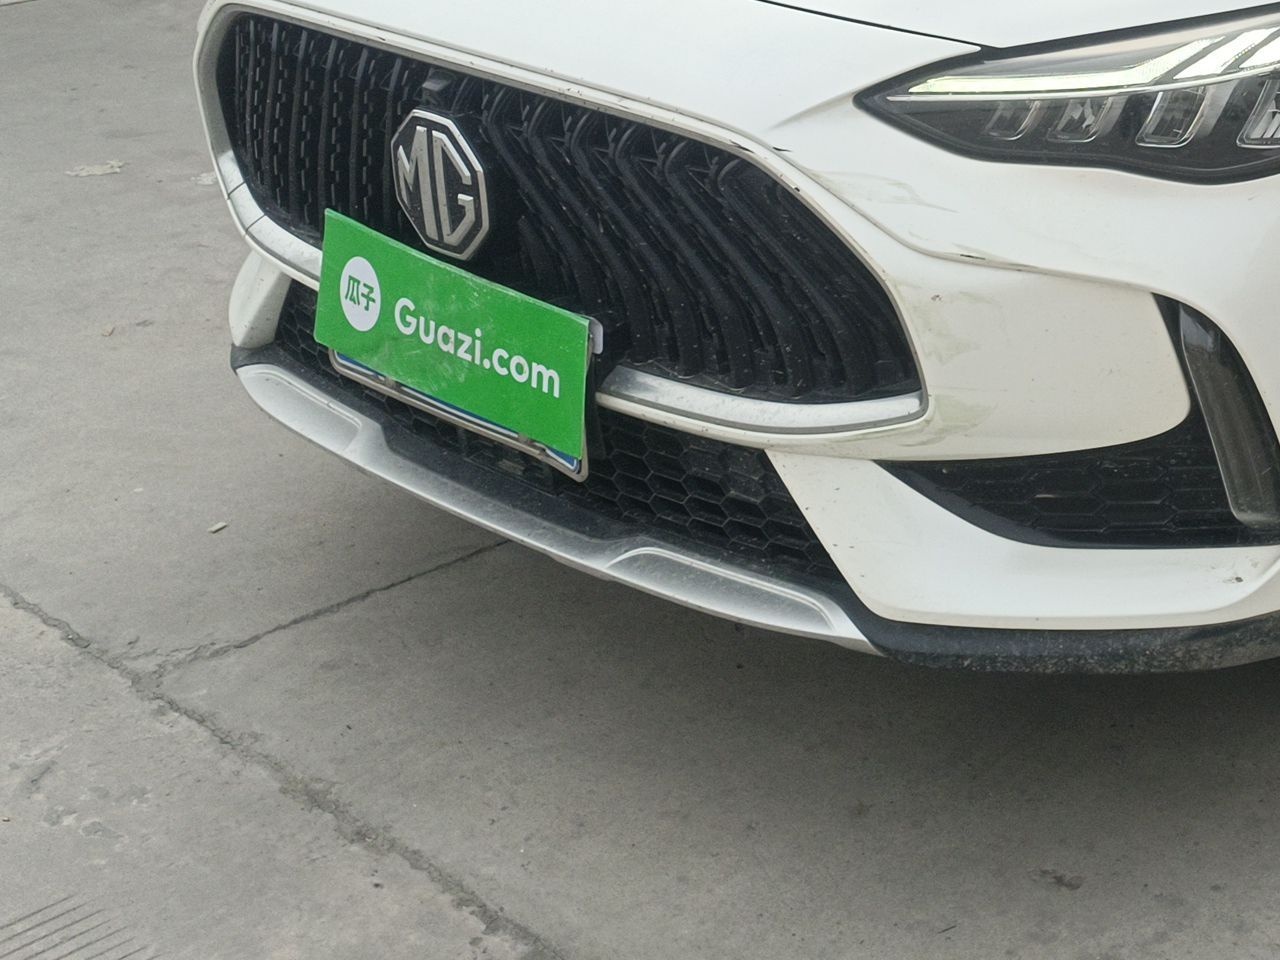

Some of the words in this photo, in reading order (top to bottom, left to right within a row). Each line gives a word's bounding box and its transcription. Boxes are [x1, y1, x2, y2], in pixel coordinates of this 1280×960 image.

[398, 125, 474, 246] MG
[345, 274, 376, 311] 瓜子
[394, 297, 560, 399] Guazi.com
